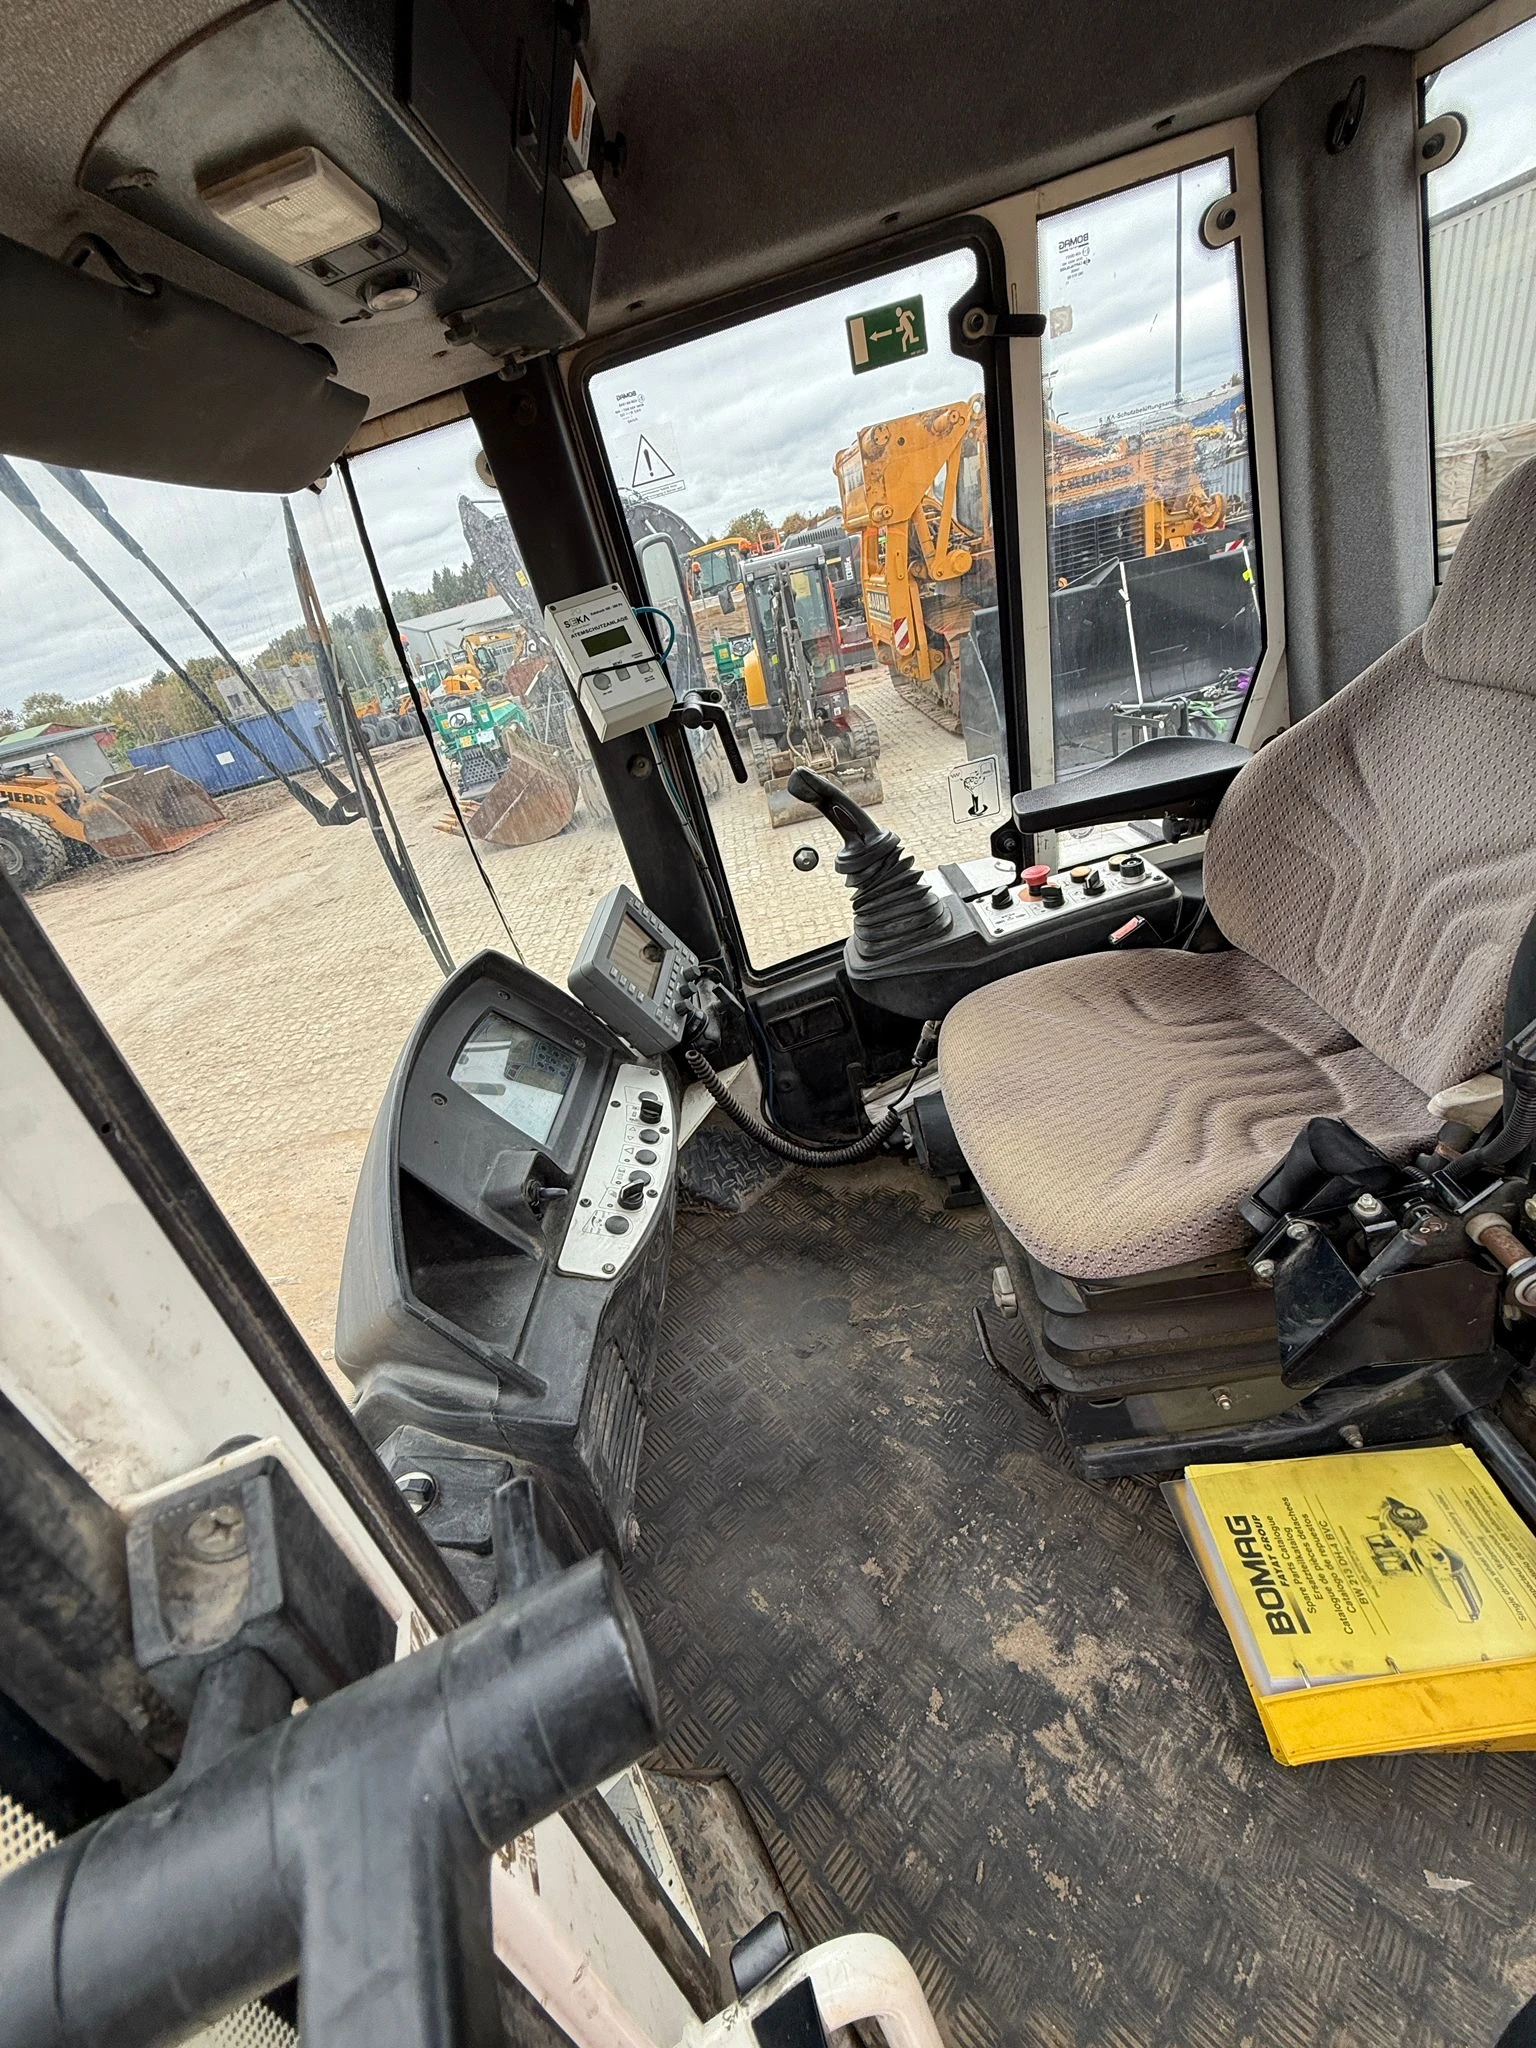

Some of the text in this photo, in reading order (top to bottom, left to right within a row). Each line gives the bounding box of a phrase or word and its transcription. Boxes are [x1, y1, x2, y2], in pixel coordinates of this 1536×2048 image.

[563, 615, 591, 628] SEKA
[571, 616, 629, 639] ATEMSCHUTZANLAGE
[1318, 1520, 1336, 1541] BVC
[1251, 1514, 1290, 1587] FAYAT GROUP
[1224, 1515, 1298, 1635] BOMAG
[1266, 1515, 1317, 1614] Spare Parts Catalogue
[1301, 1513, 1357, 1614] Catalogo de repuestos
[1317, 1573, 1329, 1584] de
[1343, 1567, 1360, 1586] 213
[1494, 1576, 1510, 1595] drum
[1354, 1586, 1370, 1605] BW
[1325, 1586, 1354, 1635] Catalogue
[1507, 1596, 1527, 1622] Single
